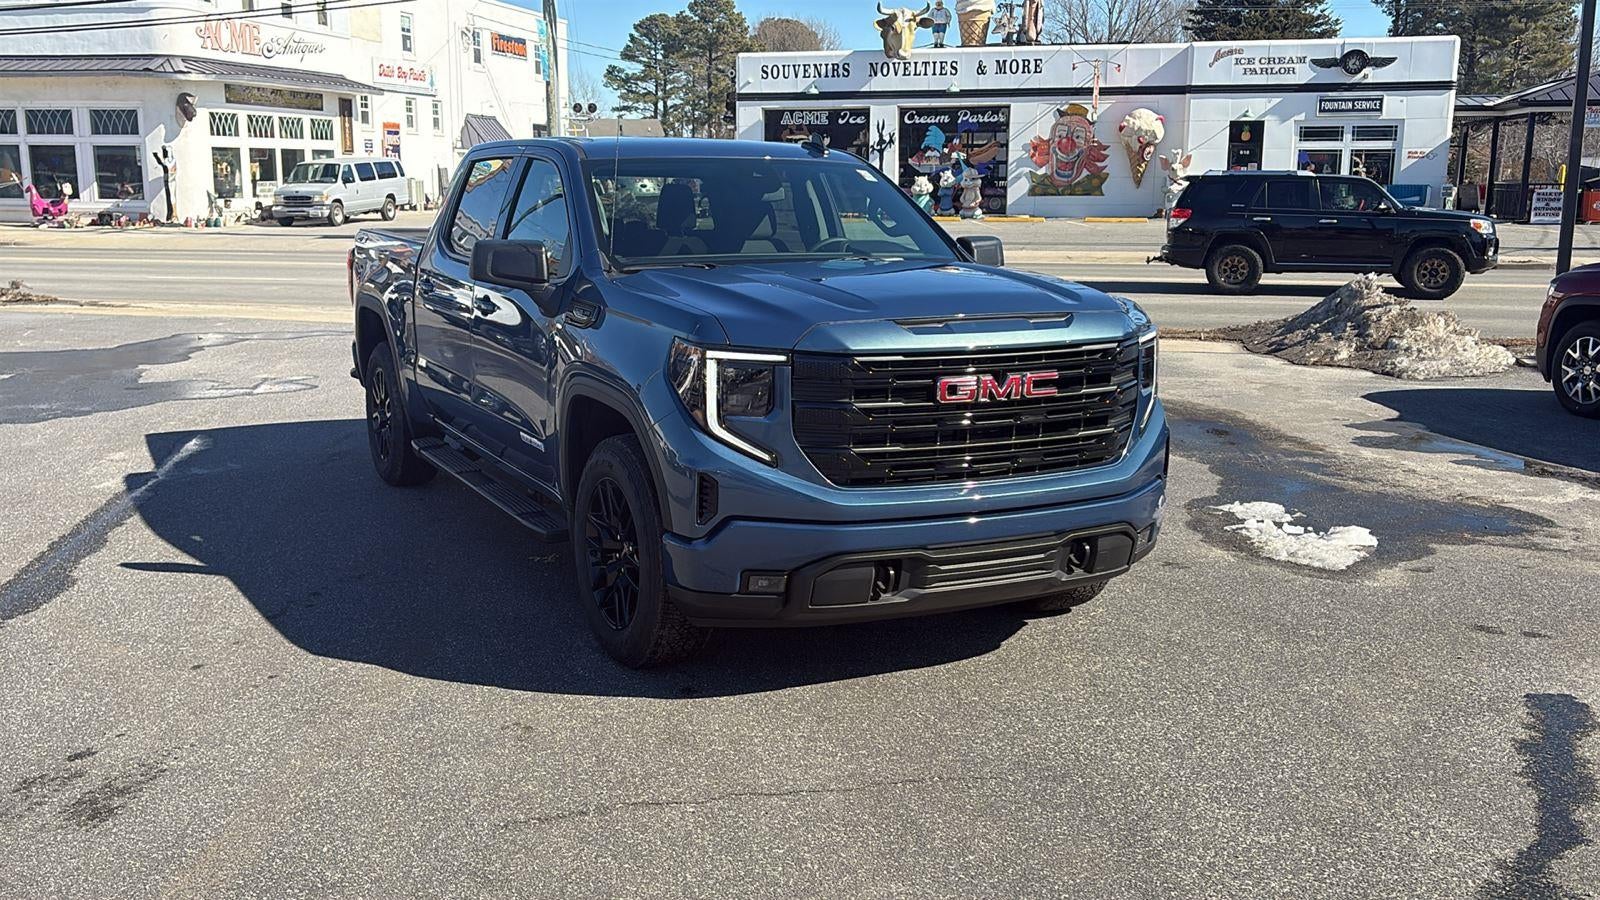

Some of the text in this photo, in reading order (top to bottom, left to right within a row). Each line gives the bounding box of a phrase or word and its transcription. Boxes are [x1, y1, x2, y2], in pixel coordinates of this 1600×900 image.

[195, 18, 326, 63] ACME Antiques
[1233, 56, 1307, 65] ICE CREAM
[379, 64, 394, 78] Dutch
[397, 66, 408, 83] Boy
[761, 59, 1043, 79] SOUVENIRS NOVELTIES & MORE
[1242, 67, 1296, 75] PARLOR
[1321, 101, 1381, 110] FOUNTAIN SERVICE
[781, 111, 866, 125] ACME Ice
[904, 109, 1006, 124] Cream Parlor
[937, 369, 1058, 403] GMC
